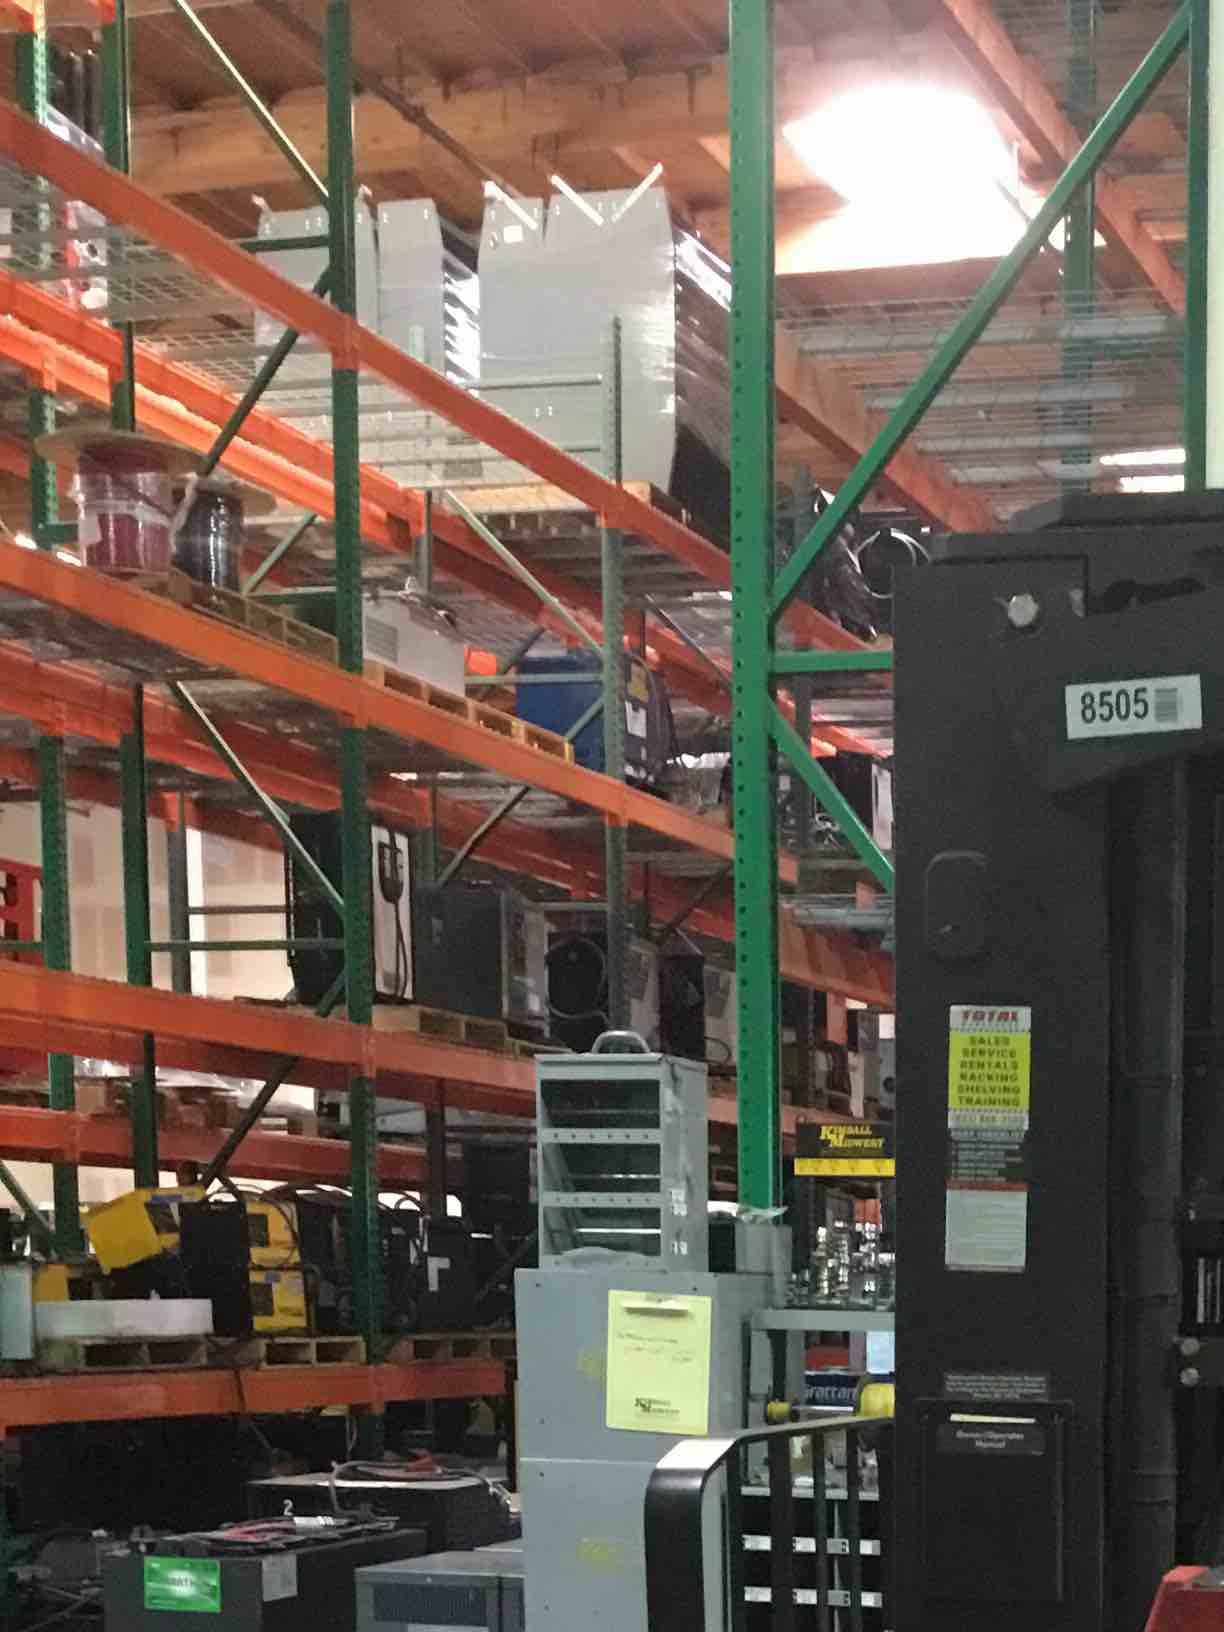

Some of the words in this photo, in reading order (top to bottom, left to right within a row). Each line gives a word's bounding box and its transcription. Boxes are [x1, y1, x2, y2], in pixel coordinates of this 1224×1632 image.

[1080, 687, 1149, 724] 8505
[969, 1036, 1011, 1046] SALES
[961, 1047, 1017, 1058] SERVICE
[957, 1096, 1021, 1107] TRAINING
